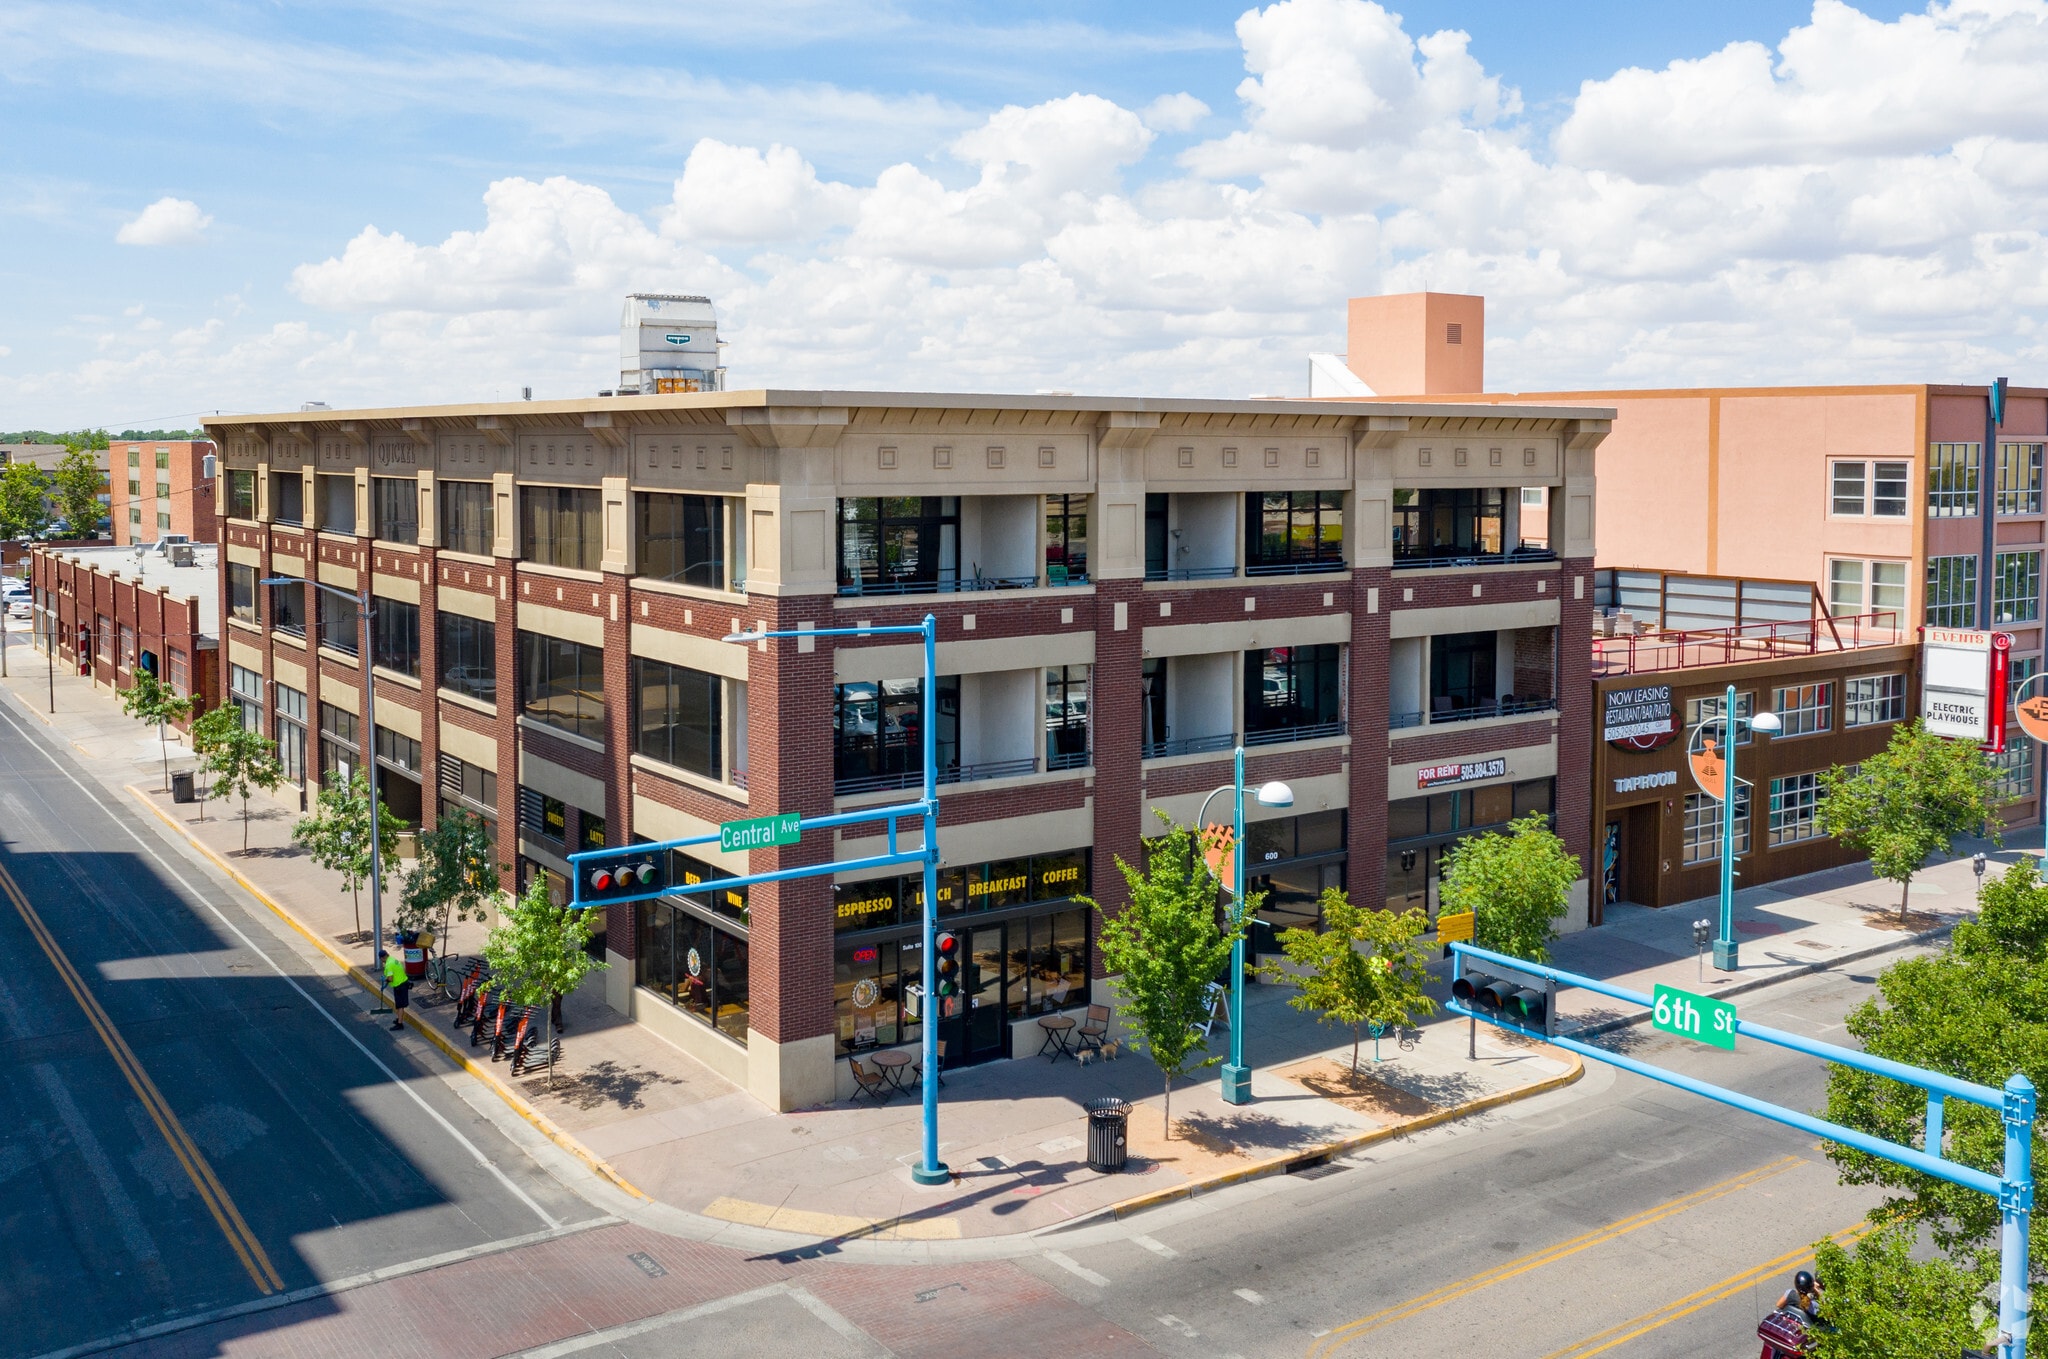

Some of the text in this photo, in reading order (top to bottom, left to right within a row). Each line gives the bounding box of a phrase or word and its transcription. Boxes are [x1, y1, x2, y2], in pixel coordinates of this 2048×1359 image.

[1932, 631, 1984, 645] EVENTS
[1609, 686, 1669, 706] NOW LEASING
[1606, 703, 1671, 725] RESTAURANT/BAR/PATIO
[1933, 702, 1975, 715] ELECTRIC
[1926, 711, 1979, 726] PLAYHOUSE
[1418, 759, 1505, 780] FOR RENT 505.884.3578
[1613, 771, 1677, 793] TAPROOM
[547, 811, 564, 828] SWEETS
[589, 829, 604, 846] LATTE
[721, 820, 799, 848] Central Ave
[1265, 851, 1279, 860] 600
[1042, 867, 1078, 885] COFFEE
[968, 875, 1027, 897] BREAKFAST
[726, 890, 743, 909] WINE
[837, 896, 893, 918] ESPRESSO
[853, 949, 877, 961] OPEN
[1654, 993, 1734, 1035] 6th St
